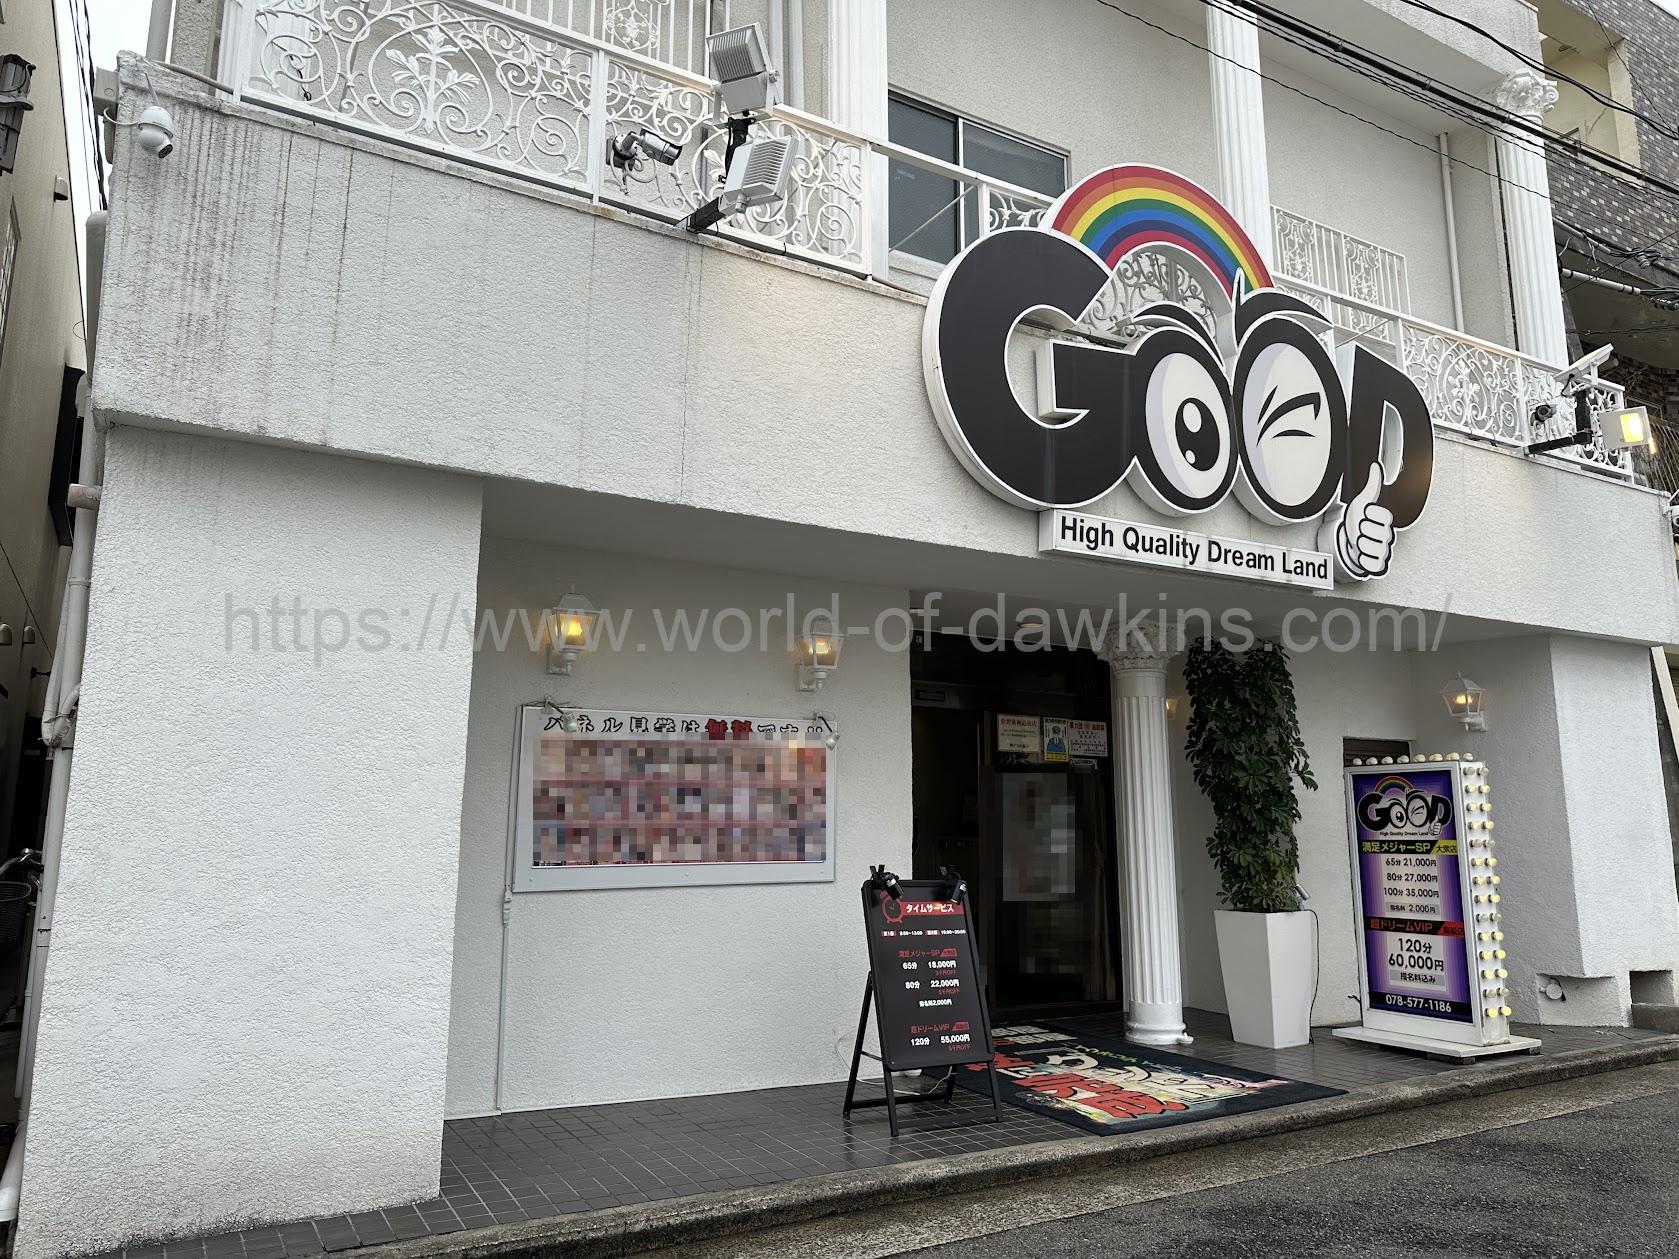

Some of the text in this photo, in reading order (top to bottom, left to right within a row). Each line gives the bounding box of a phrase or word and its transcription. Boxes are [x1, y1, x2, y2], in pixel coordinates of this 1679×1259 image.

[926, 229, 1434, 531] GOOD
[1060, 515, 1329, 580] High Quality Dream Land
[1357, 790, 1453, 831] GOOD
[1362, 841, 1431, 853] 満足メジャーSP
[1385, 857, 1437, 868] 65分 21,000円
[1386, 873, 1438, 884] 80分 27,000円
[1383, 887, 1440, 899] 100分 35,000円
[906, 903, 954, 913] タイムサービス
[1408, 905, 1436, 914] 2,000円
[1370, 918, 1433, 933] 超ドリームVIP
[1398, 938, 1432, 954] 120分
[902, 960, 957, 970] 65分 18,000円
[1388, 953, 1444, 972] 60,000円
[1400, 972, 1436, 983] 指名料込み
[905, 979, 960, 990] 80分 22,000円
[1385, 994, 1452, 1013] 078-577-1186
[910, 1034, 971, 1046] 120分 55,000円
